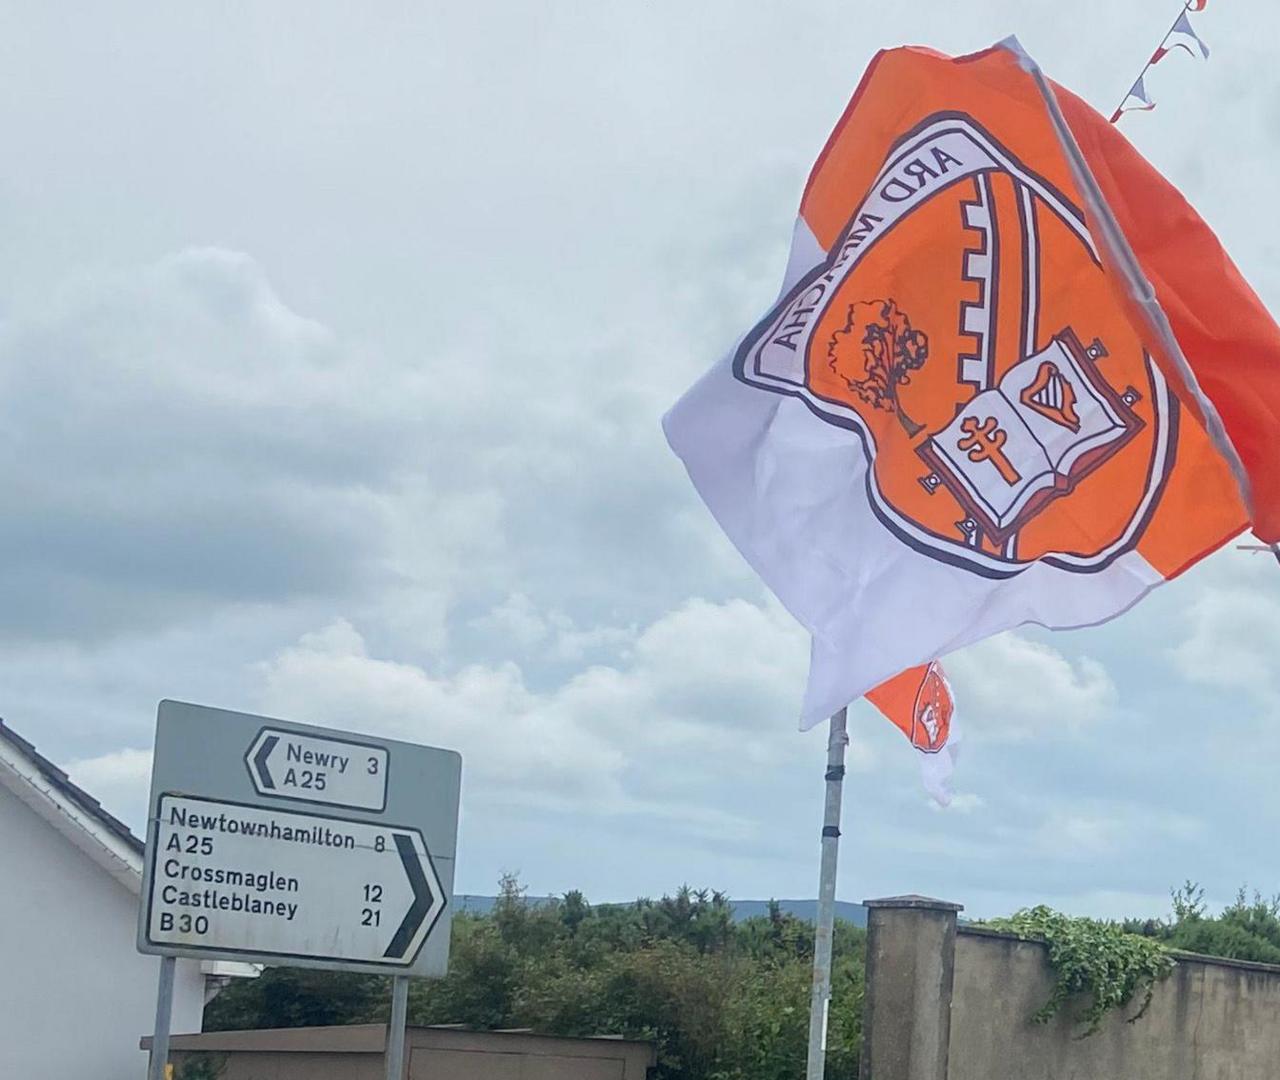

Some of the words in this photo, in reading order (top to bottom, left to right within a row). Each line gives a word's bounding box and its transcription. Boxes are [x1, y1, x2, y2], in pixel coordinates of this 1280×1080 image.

[286, 743, 350, 774] Newry
[366, 757, 379, 776] 3
[283, 768, 327, 791] A25
[166, 833, 214, 856] A25
[169, 807, 356, 850] Newtownhamilton
[373, 835, 386, 853] 8
[164, 859, 299, 893] Crossmaglen
[363, 884, 383, 903] 12
[161, 885, 298, 920] Castleblaney
[361, 909, 381, 927] 21
[159, 912, 209, 936] B30
